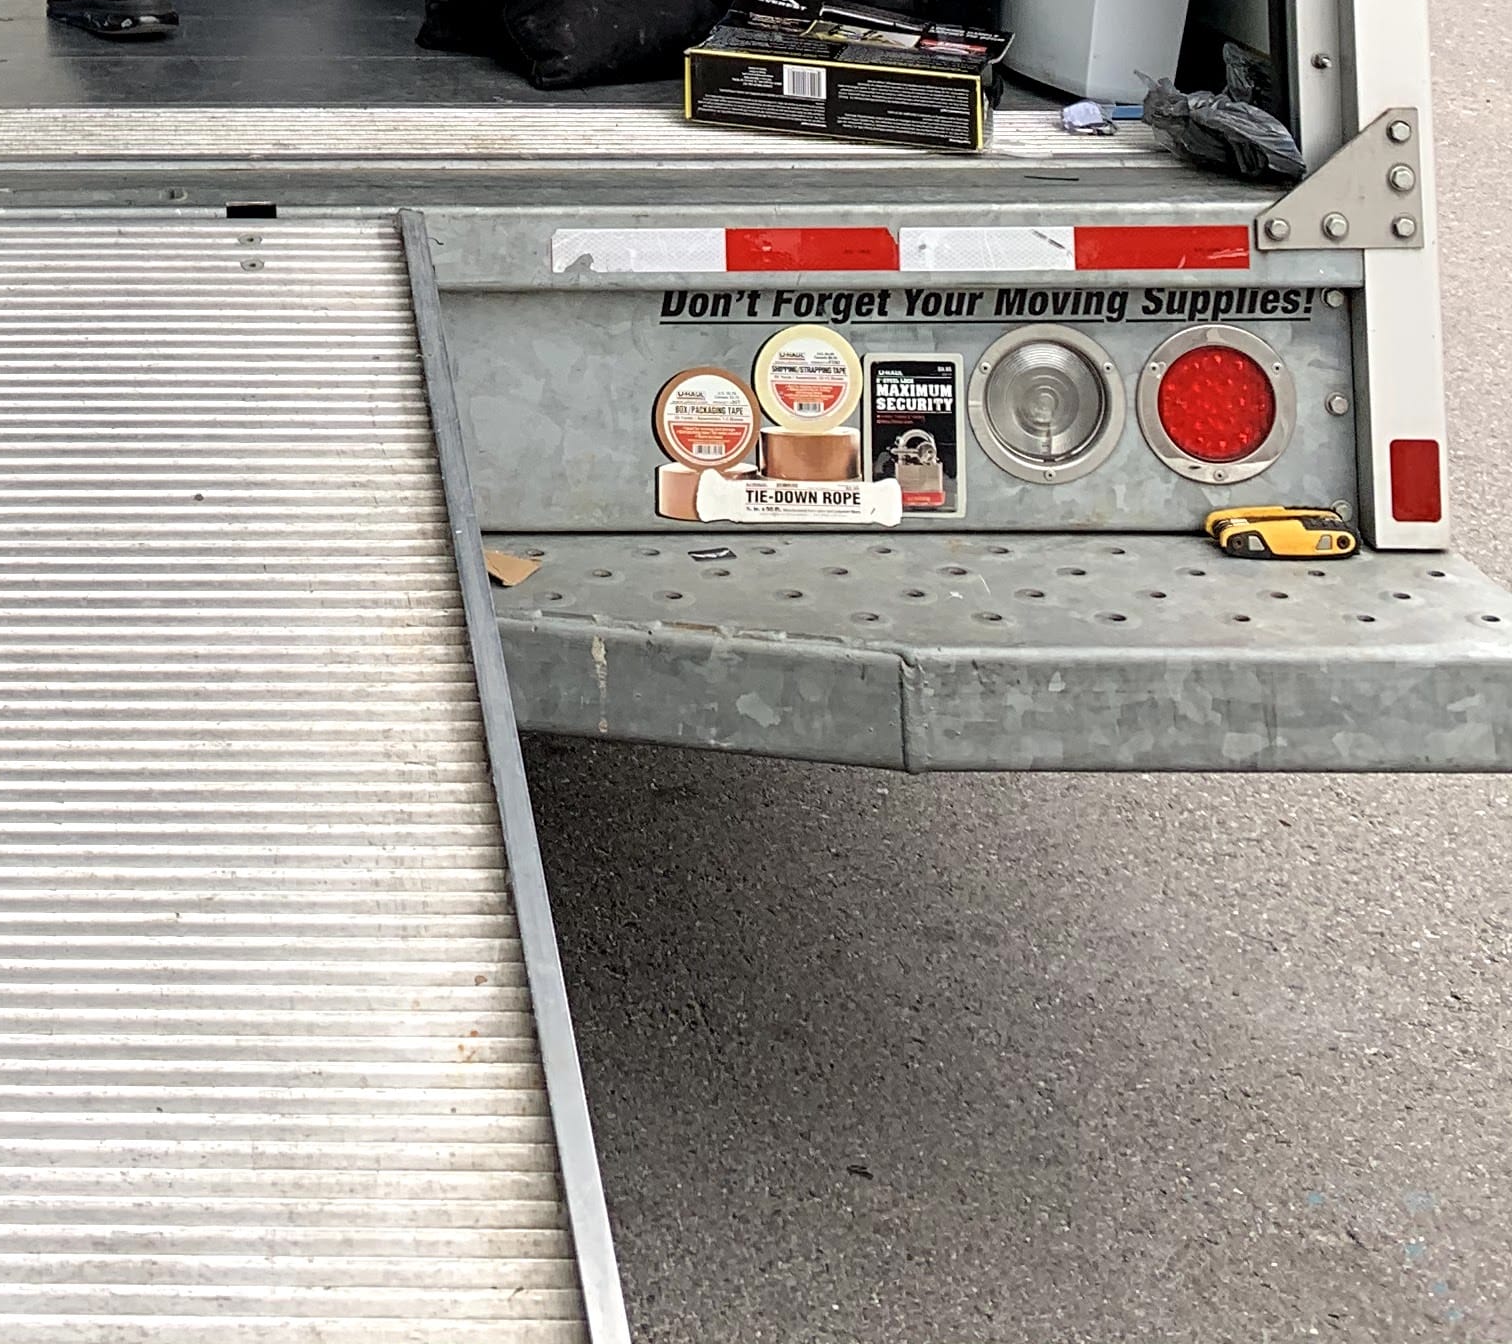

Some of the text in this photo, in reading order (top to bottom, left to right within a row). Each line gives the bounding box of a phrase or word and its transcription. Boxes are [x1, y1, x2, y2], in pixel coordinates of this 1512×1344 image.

[660, 287, 1316, 324] Don't Forget Your Moving Supplies!
[876, 384, 953, 397] MAXIMUM
[728, 407, 743, 415] TAPE
[876, 397, 953, 411] SECURITY
[746, 490, 861, 505] TIE-DOWN ROPE
